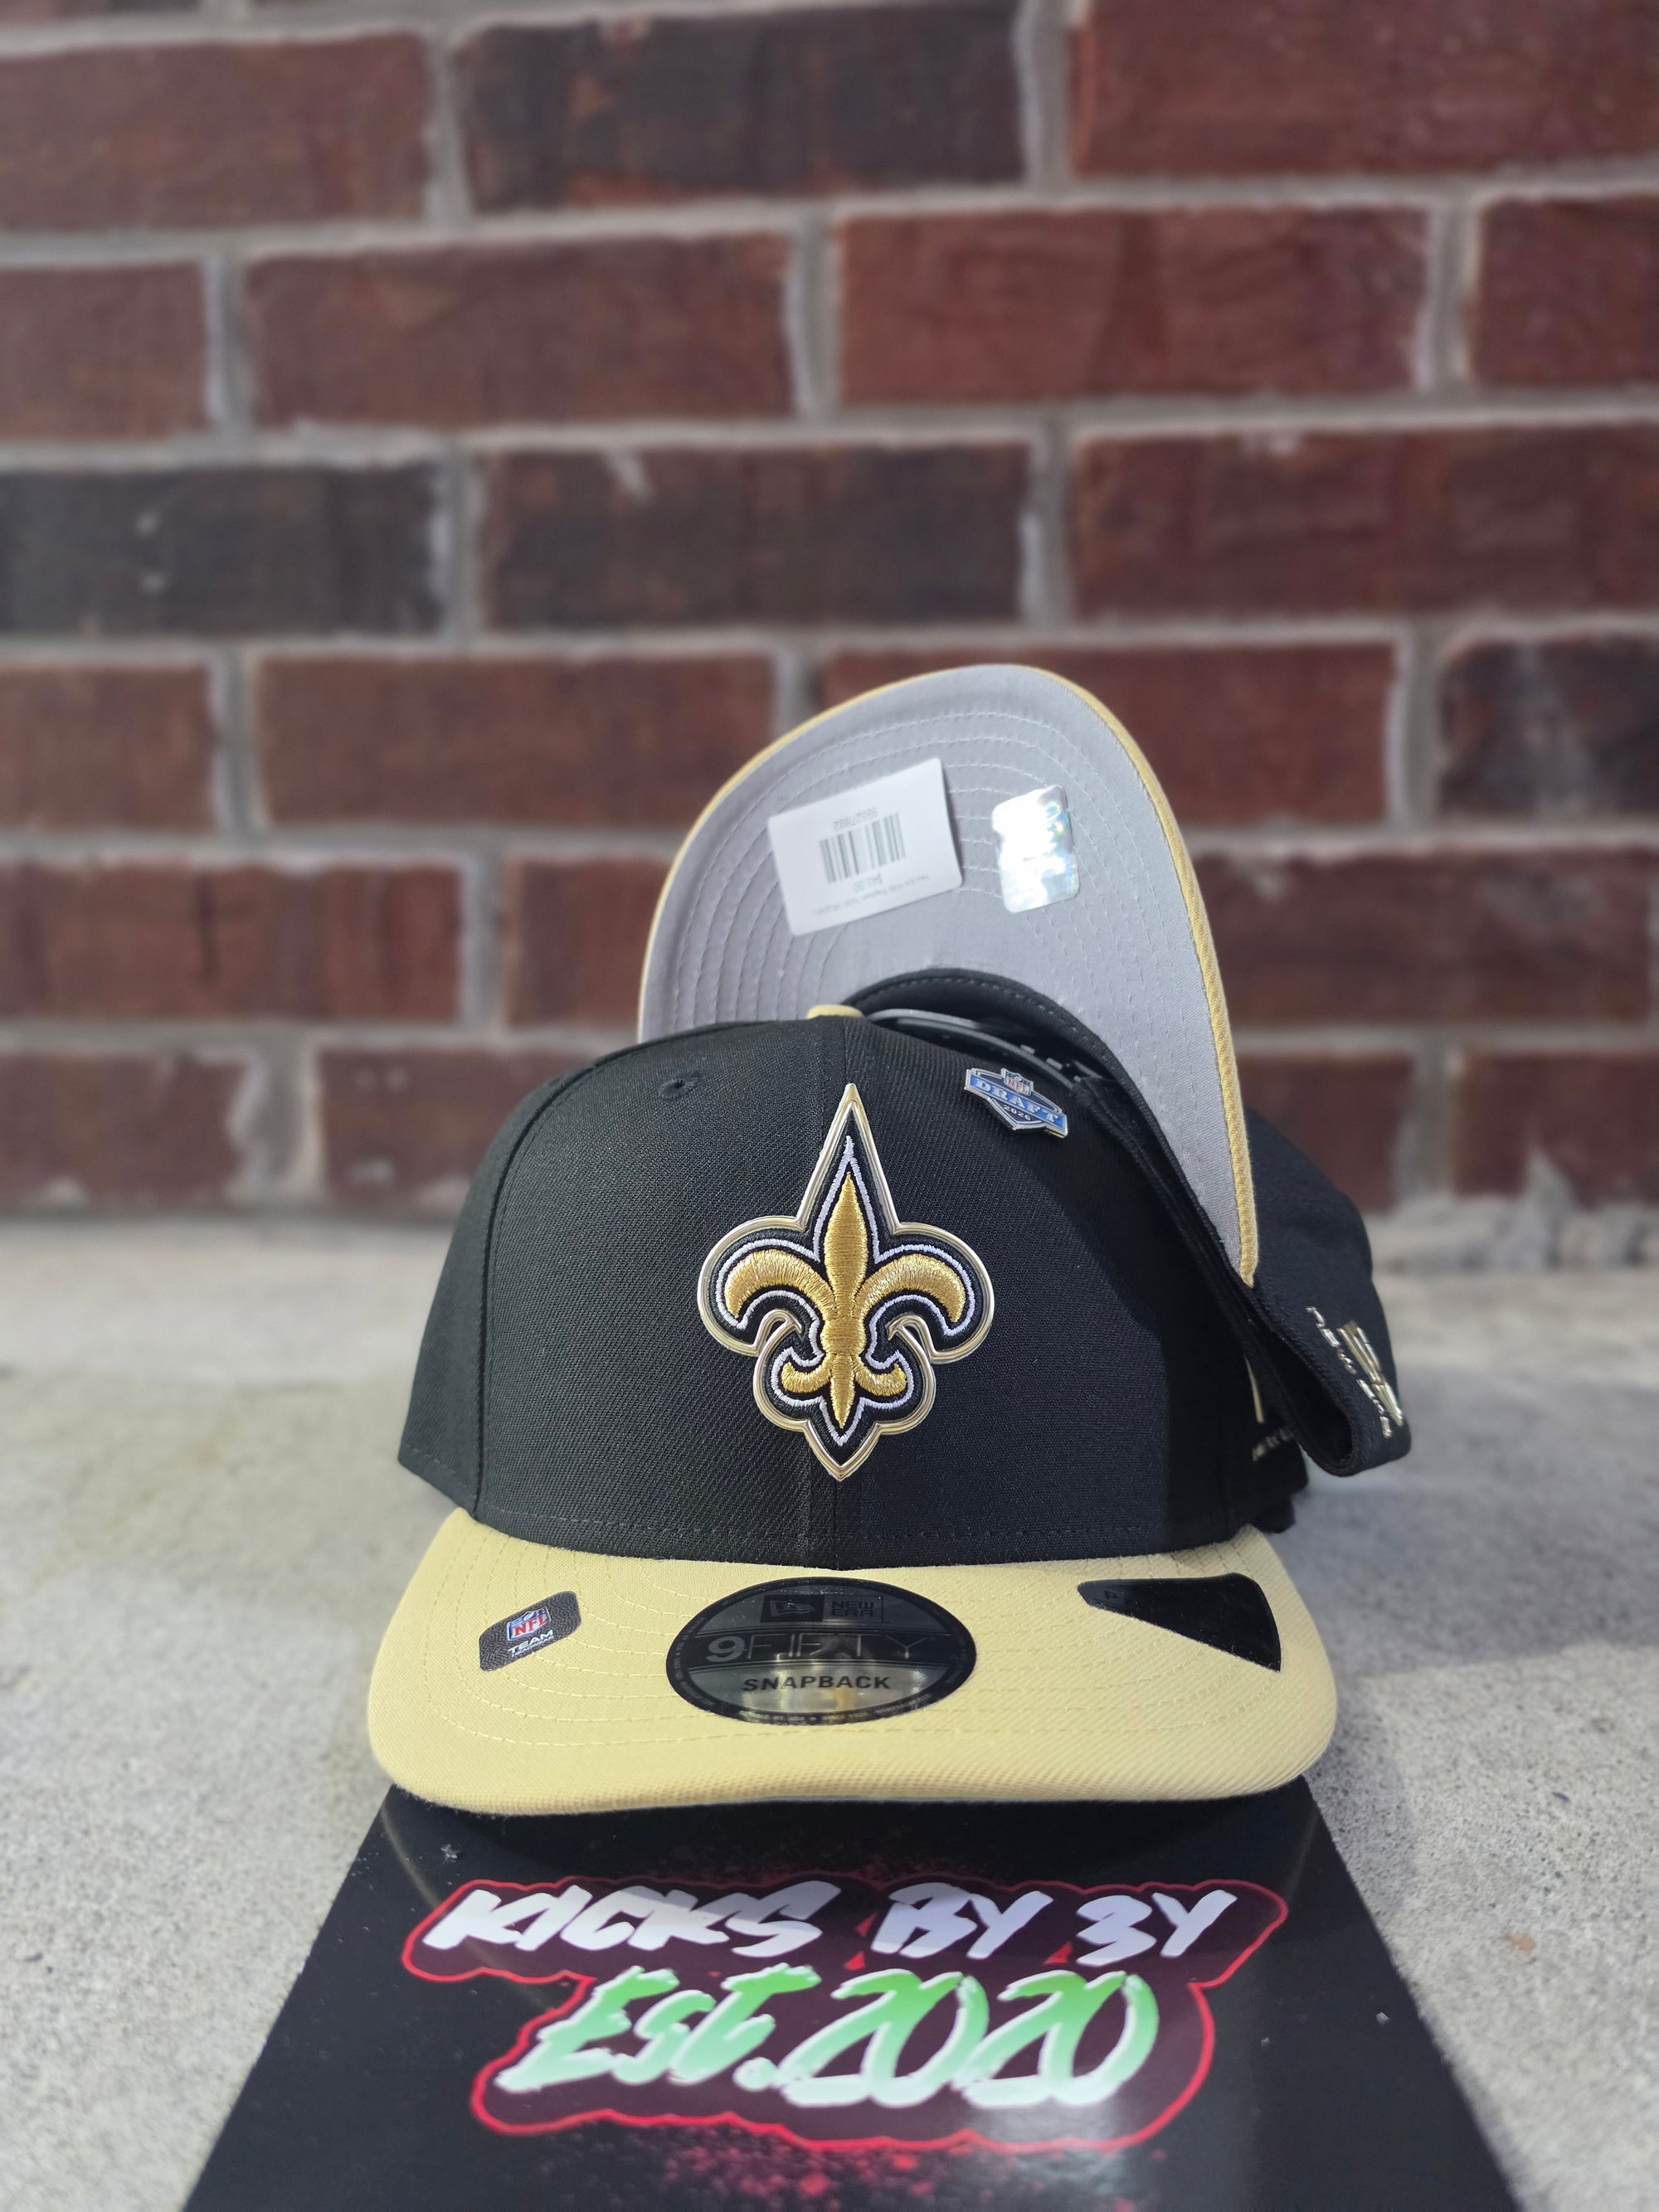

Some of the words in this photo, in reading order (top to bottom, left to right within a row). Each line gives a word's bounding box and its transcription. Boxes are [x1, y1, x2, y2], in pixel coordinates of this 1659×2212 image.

[1007, 1078, 1029, 1093] NFL
[975, 1077, 1059, 1122] DRAFT
[832, 1601, 874, 1609] NEW
[514, 1615, 547, 1636] NFL
[507, 1629, 553, 1654] TEAM
[706, 1632, 929, 1663] 9FIFTY
[743, 1675, 891, 1692] SNAPBACK
[422, 1880, 842, 1958] KICKS
[870, 1882, 1054, 1960] BY
[1076, 1889, 1238, 1966] 3Y
